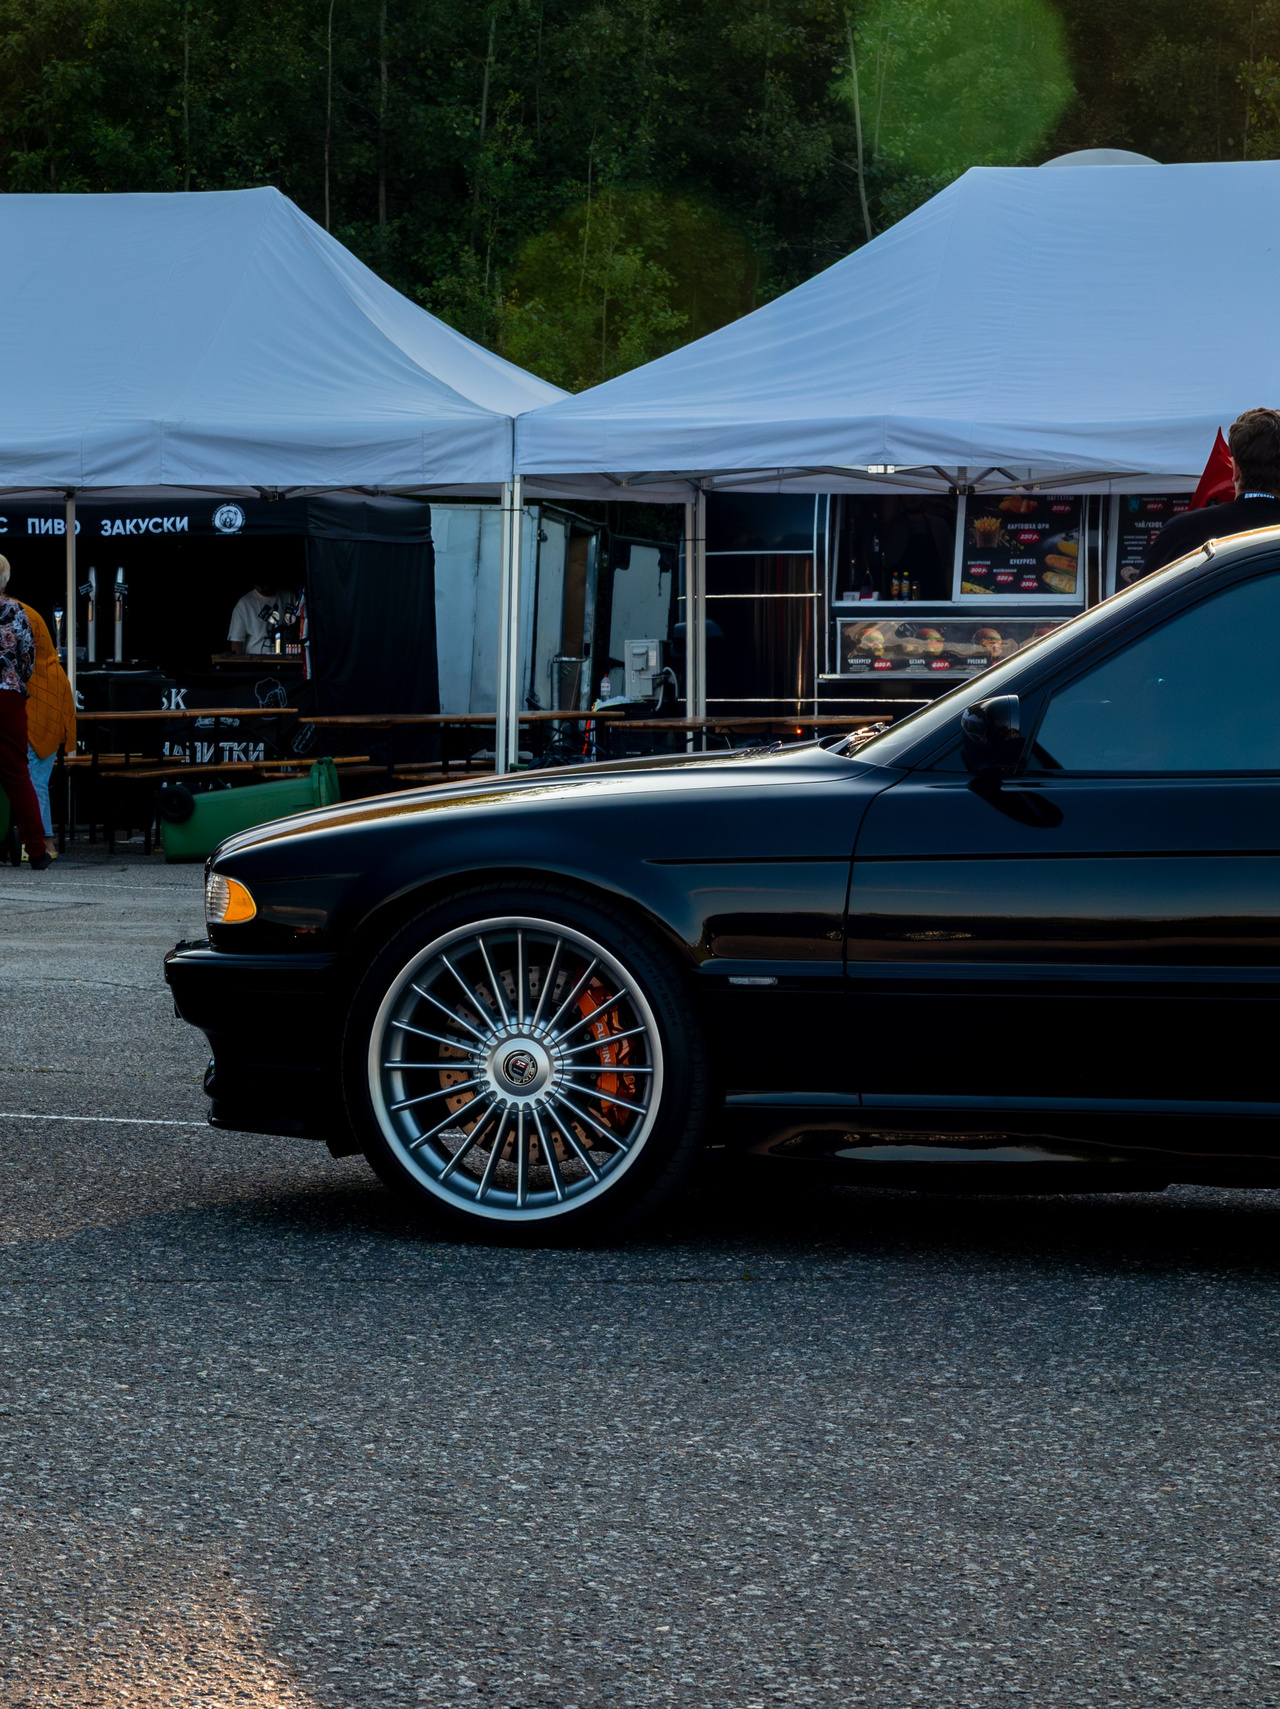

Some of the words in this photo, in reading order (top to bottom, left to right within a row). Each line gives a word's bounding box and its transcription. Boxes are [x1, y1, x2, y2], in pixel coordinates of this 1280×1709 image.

[100, 516, 189, 537] ЗАКУСКИ
[1009, 558, 1037, 566] КУКУРУЗА
[966, 657, 988, 665] РУССКИЙ
[594, 1022, 612, 1064] ALIN
